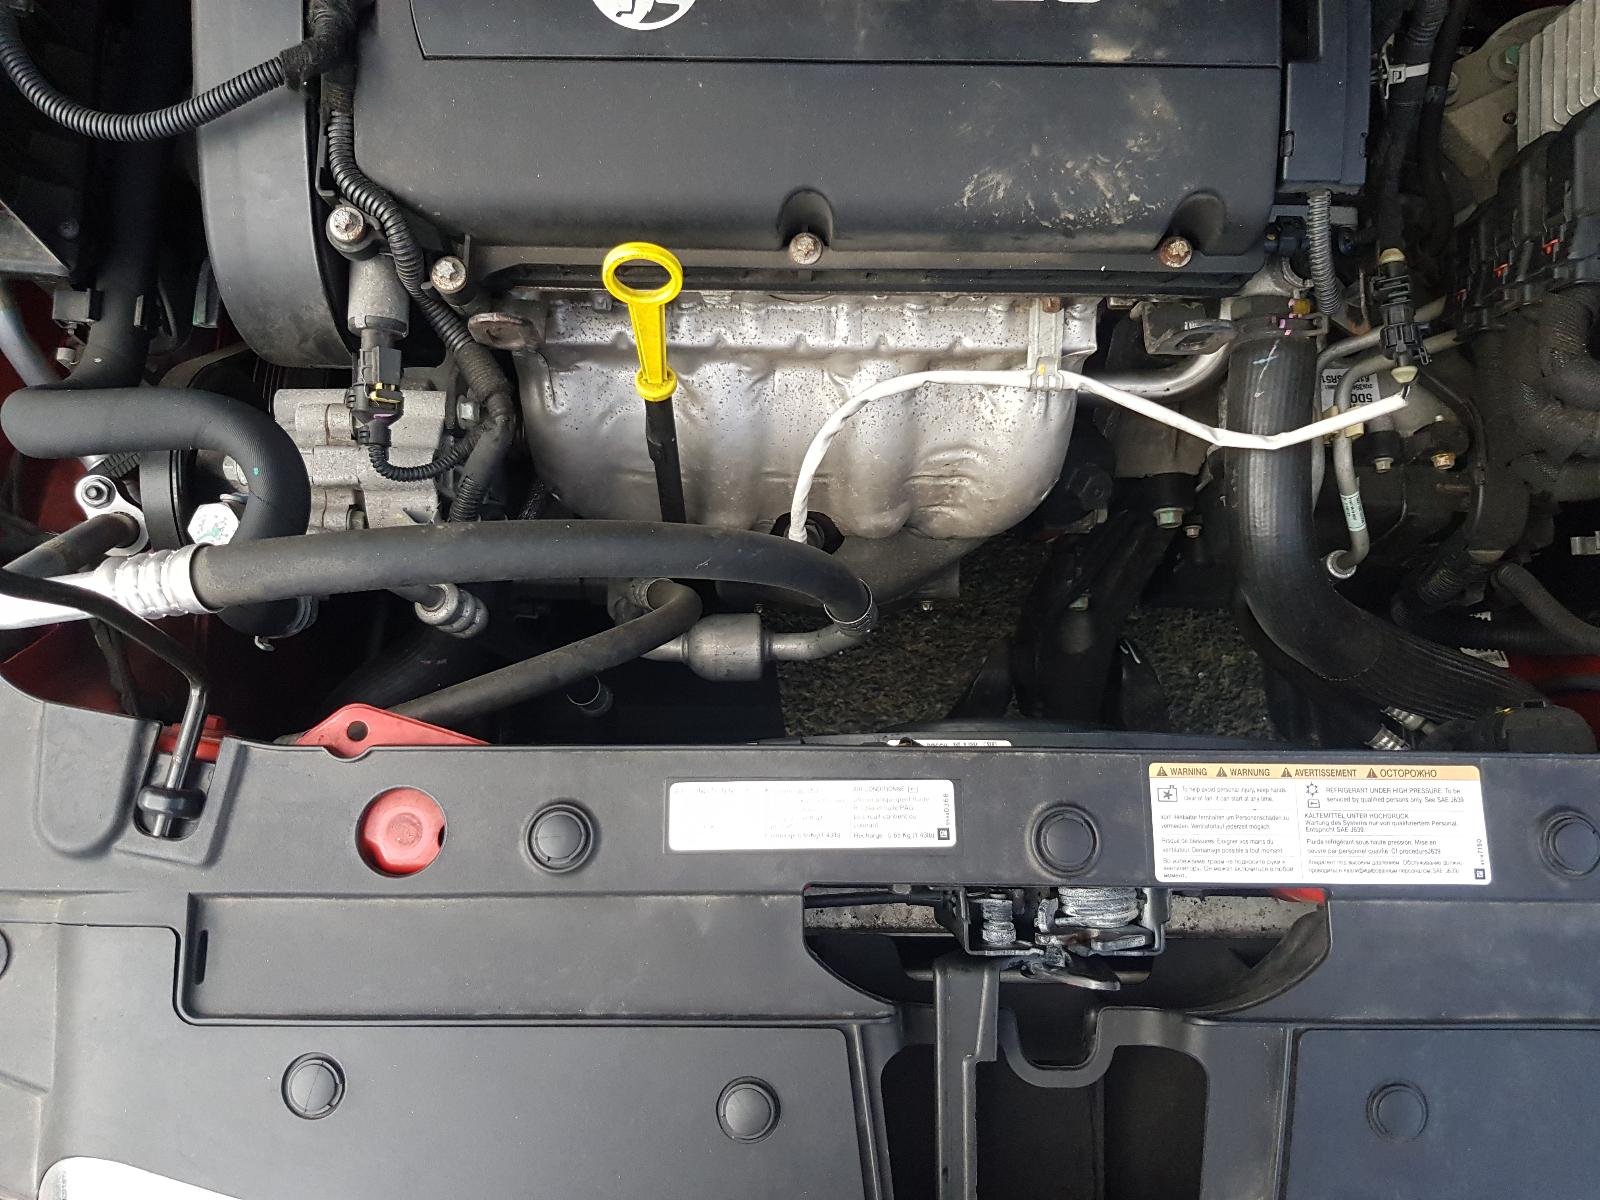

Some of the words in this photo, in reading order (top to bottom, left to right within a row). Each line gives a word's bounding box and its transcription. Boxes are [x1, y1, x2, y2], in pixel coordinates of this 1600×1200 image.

[1170, 768, 1207, 776] WARNING
[1230, 768, 1270, 777] WARNUNG
[1295, 769, 1356, 777] AVERTISSEMENT
[1380, 769, 1437, 778] ОСТОРОЖНО
